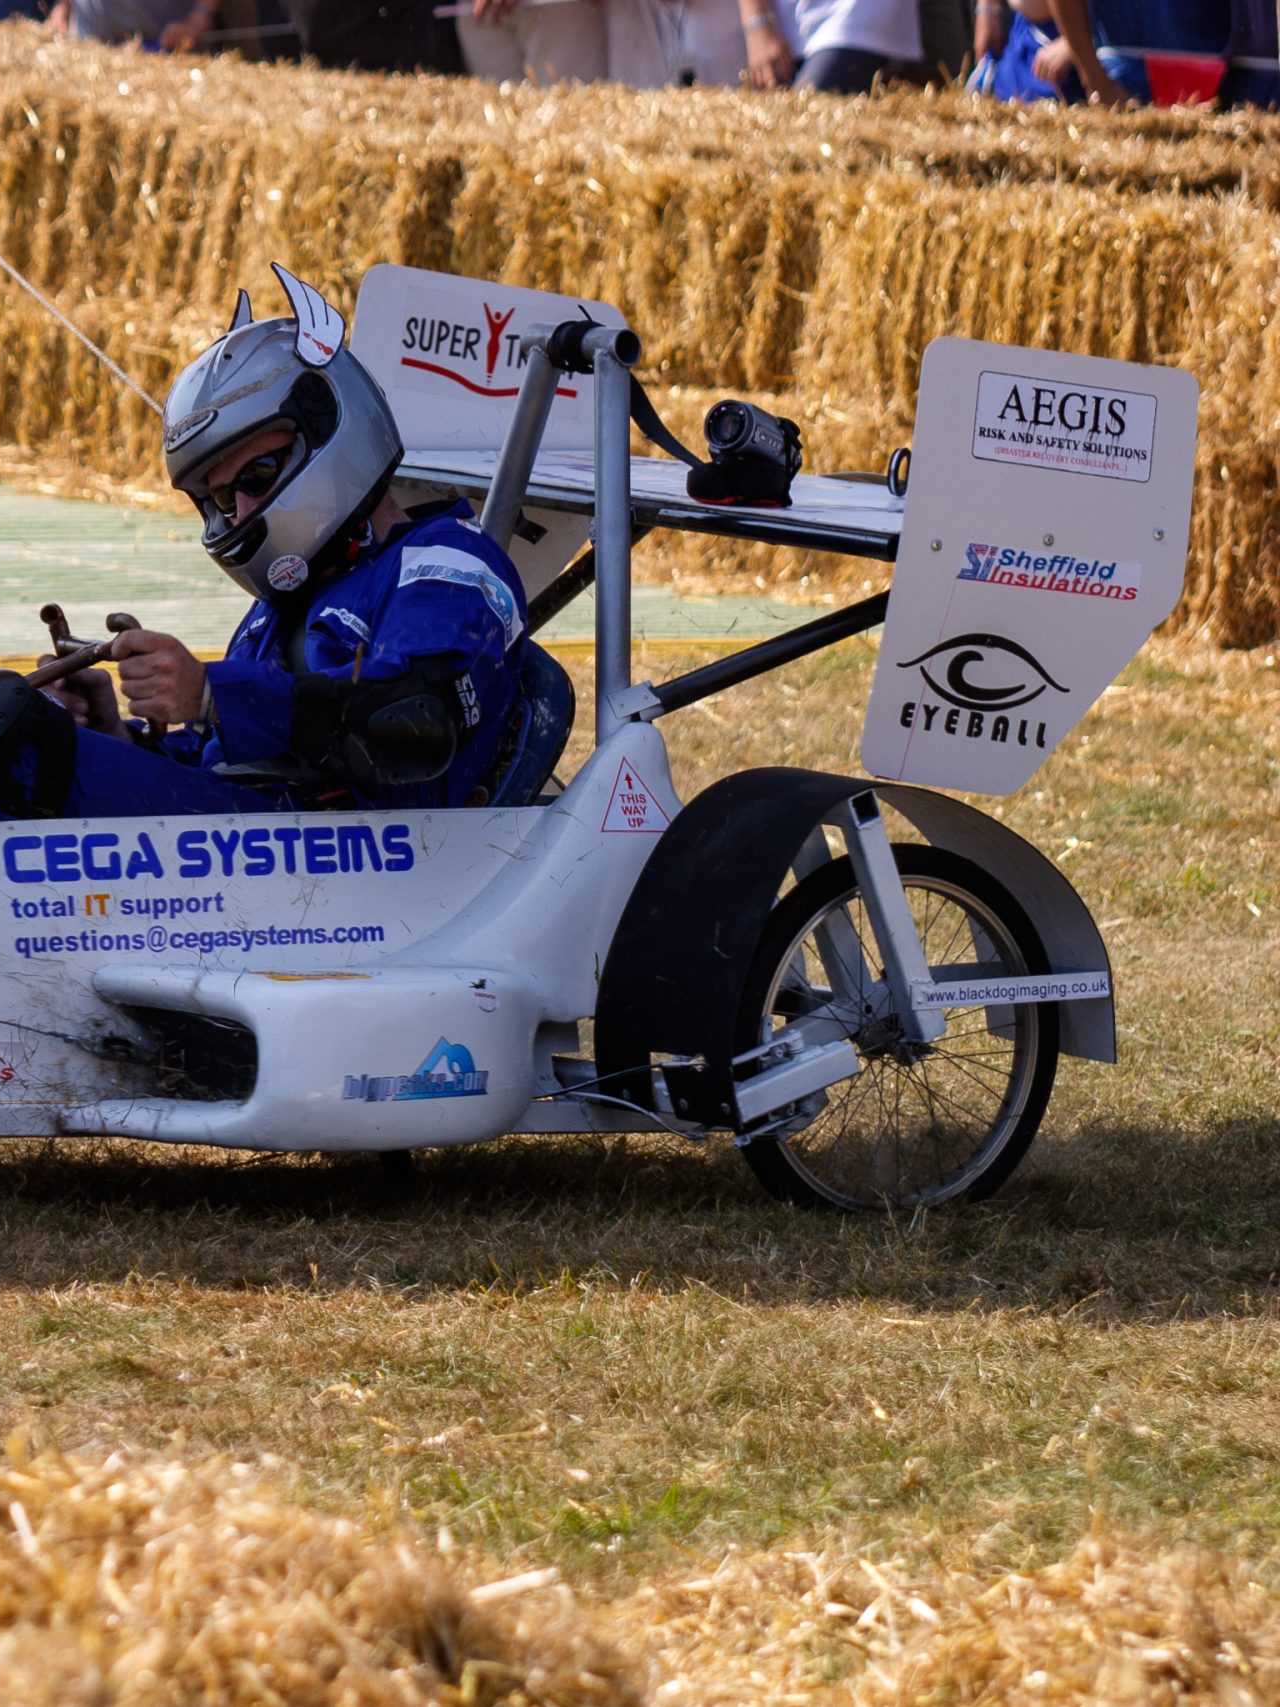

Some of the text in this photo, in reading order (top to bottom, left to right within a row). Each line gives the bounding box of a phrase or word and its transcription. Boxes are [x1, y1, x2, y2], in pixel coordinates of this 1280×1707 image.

[402, 316, 482, 361] SUPER
[997, 383, 1128, 437] AEGIS
[978, 426, 1148, 460] RISK AND SAFETY SOLUTIONS
[998, 548, 1117, 580] Sheffield
[988, 565, 1138, 600] Insulations
[900, 702, 1047, 748] EYEBALL
[619, 793, 647, 804] THIS
[621, 805, 647, 815] WAY
[627, 817, 645, 828] UP
[2, 824, 415, 884] CEGA SYSTEMS
[11, 891, 224, 920] total IT support
[14, 922, 385, 958] questions@cegasystems.com
[926, 978, 1108, 1003] www.blackdogimaging.co.uk
